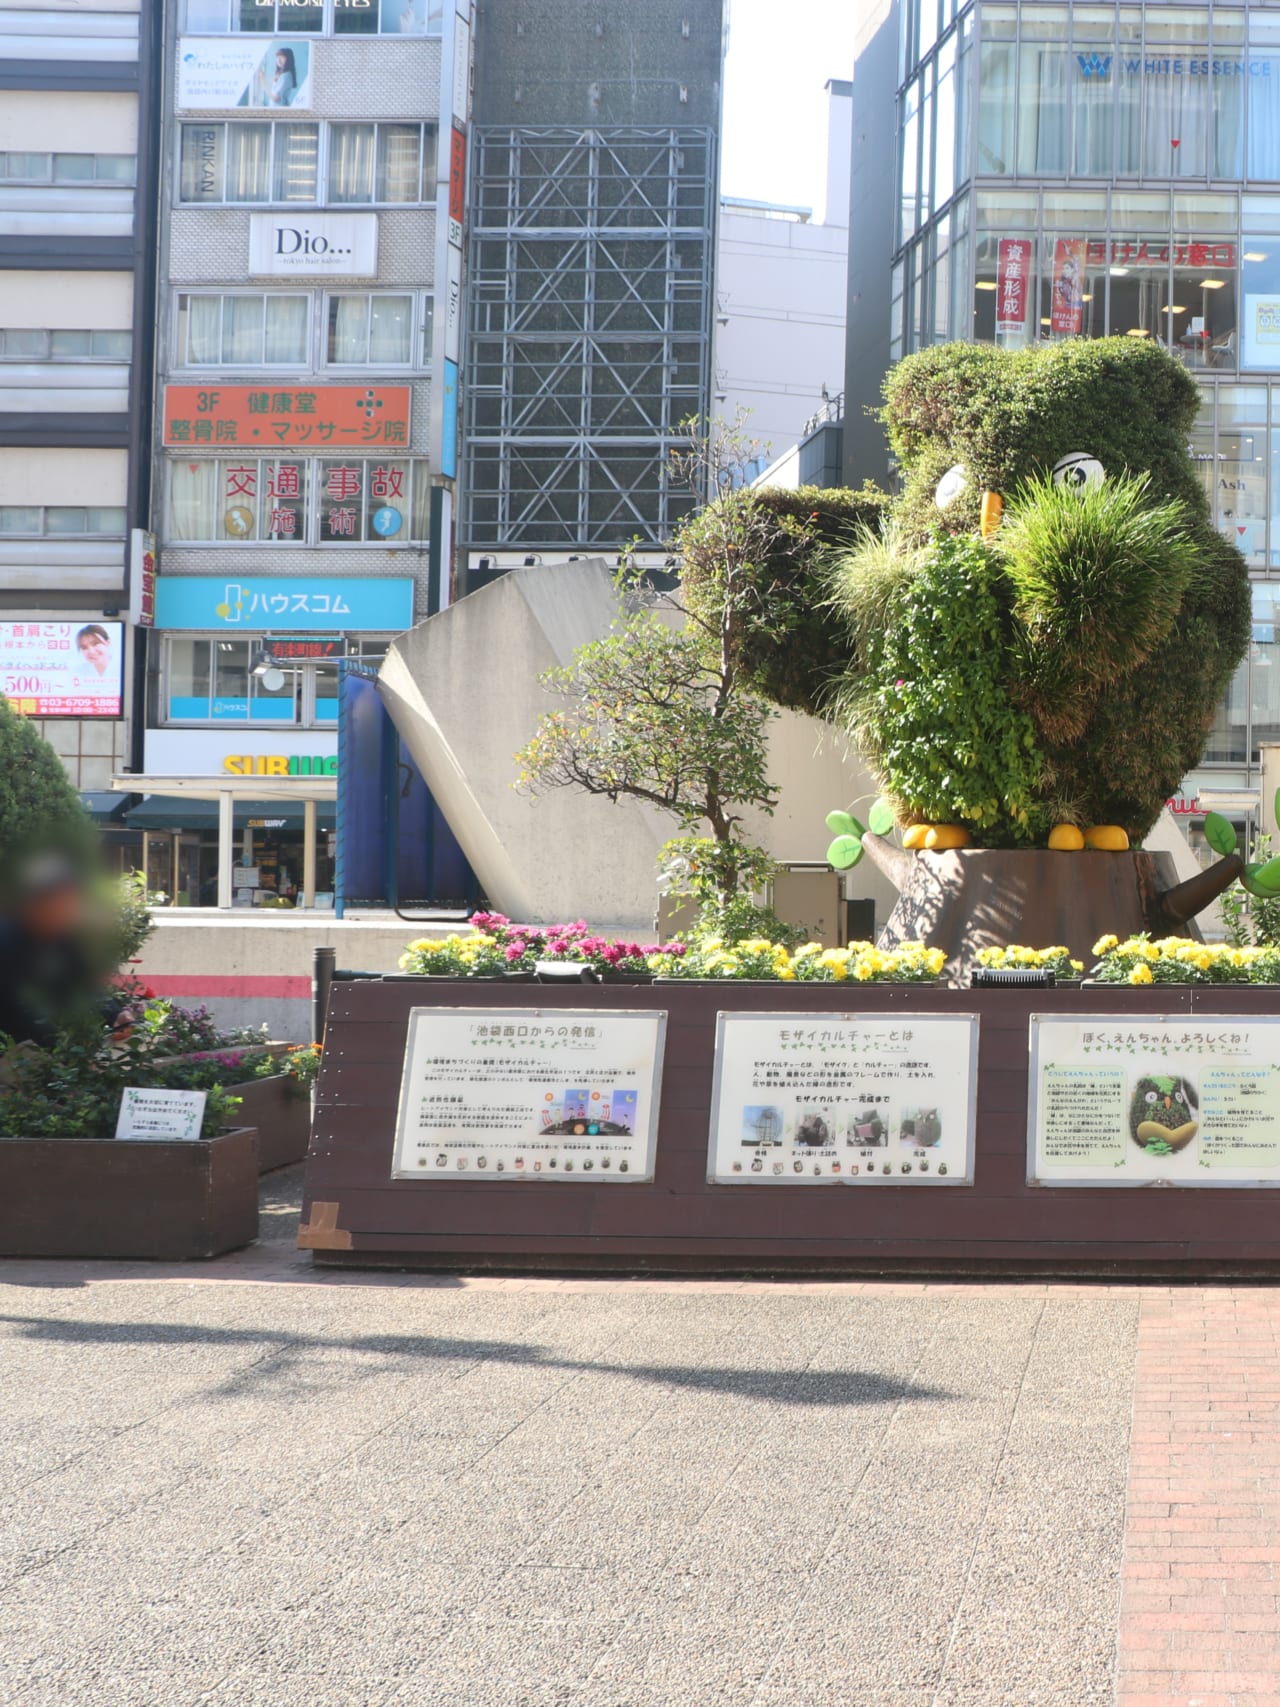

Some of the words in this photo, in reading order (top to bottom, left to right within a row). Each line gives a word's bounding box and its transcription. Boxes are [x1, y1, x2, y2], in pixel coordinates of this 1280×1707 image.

[1124, 60, 1182, 74] WHITE
[1190, 61, 1271, 77] ESSENCE
[201, 131, 216, 192] RINKAN
[1086, 242, 1234, 267] ほけんの窓口
[1003, 245, 1023, 315] 資産形成
[197, 392, 220, 413] 3F
[248, 392, 318, 414] 健康堂
[226, 466, 404, 501] 交通事故
[1218, 479, 1246, 490] Ash
[270, 508, 357, 535] 施術
[250, 593, 350, 614] ハウスコム
[247, 819, 287, 828] SUBWAY
[779, 1030, 913, 1041] モザイカルチャーとは
